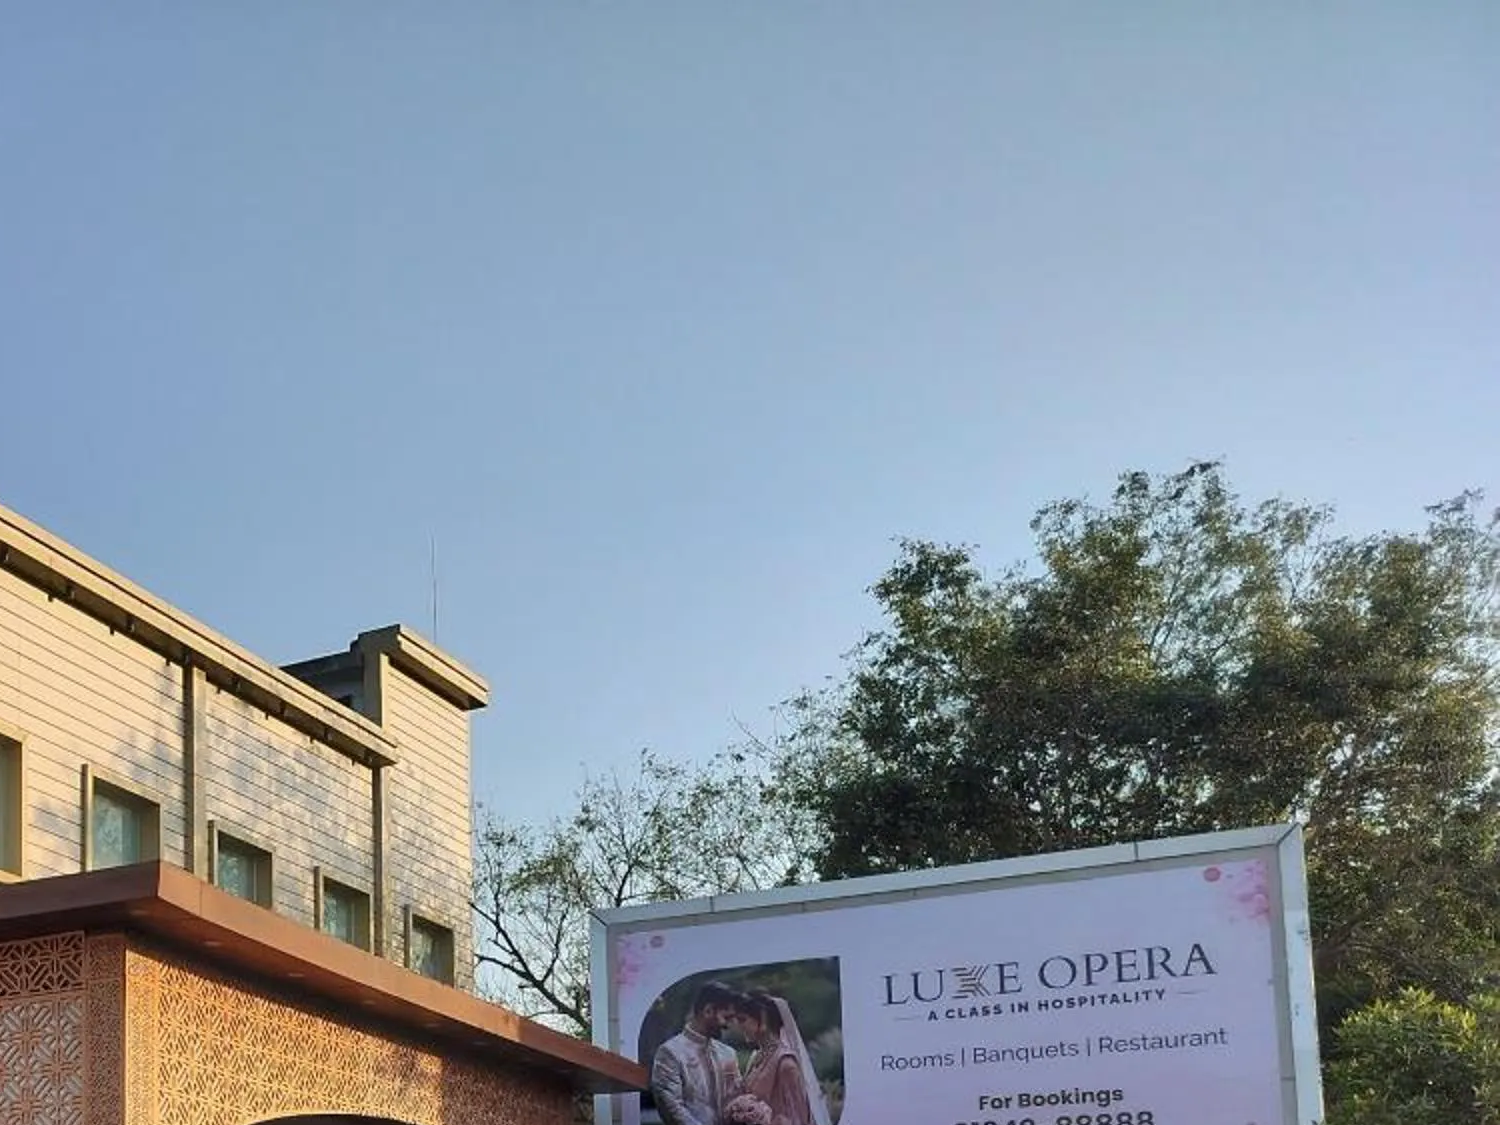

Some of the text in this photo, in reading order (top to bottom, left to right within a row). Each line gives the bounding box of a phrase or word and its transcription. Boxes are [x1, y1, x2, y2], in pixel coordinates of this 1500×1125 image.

[1038, 943, 1218, 989] OPERA
[928, 989, 1166, 1021] A CLASS IN HOSPITALITY
[881, 1028, 1228, 1070] Rooms Banquets Restaurant
[979, 1087, 1124, 1110] For Bookings
